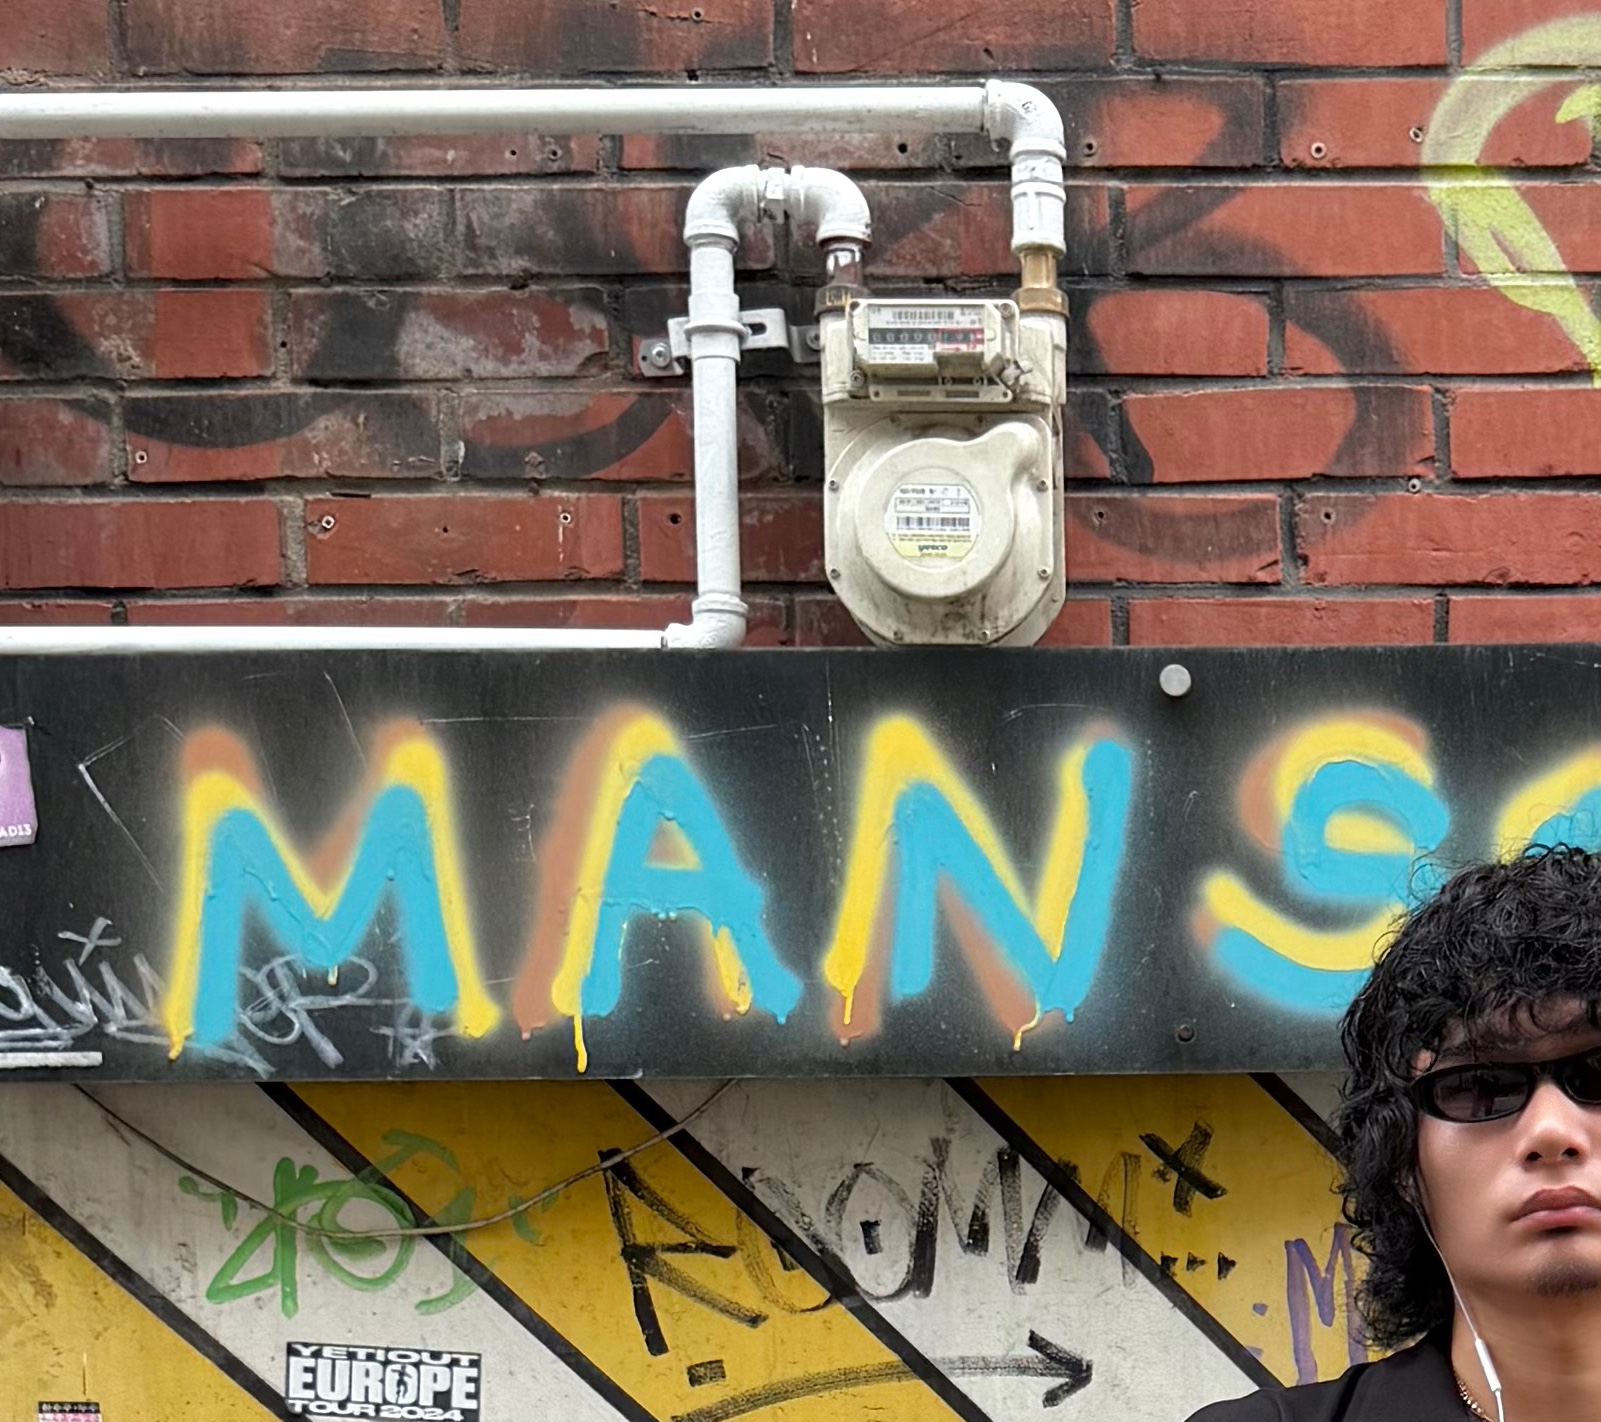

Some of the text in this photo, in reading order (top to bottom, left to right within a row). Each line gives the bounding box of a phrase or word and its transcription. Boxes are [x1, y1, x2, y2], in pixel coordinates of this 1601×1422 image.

[291, 1344, 479, 1367] YETIOUT
[288, 1356, 479, 1410] EUROPE
[288, 1399, 465, 1422] TOUR 2024
